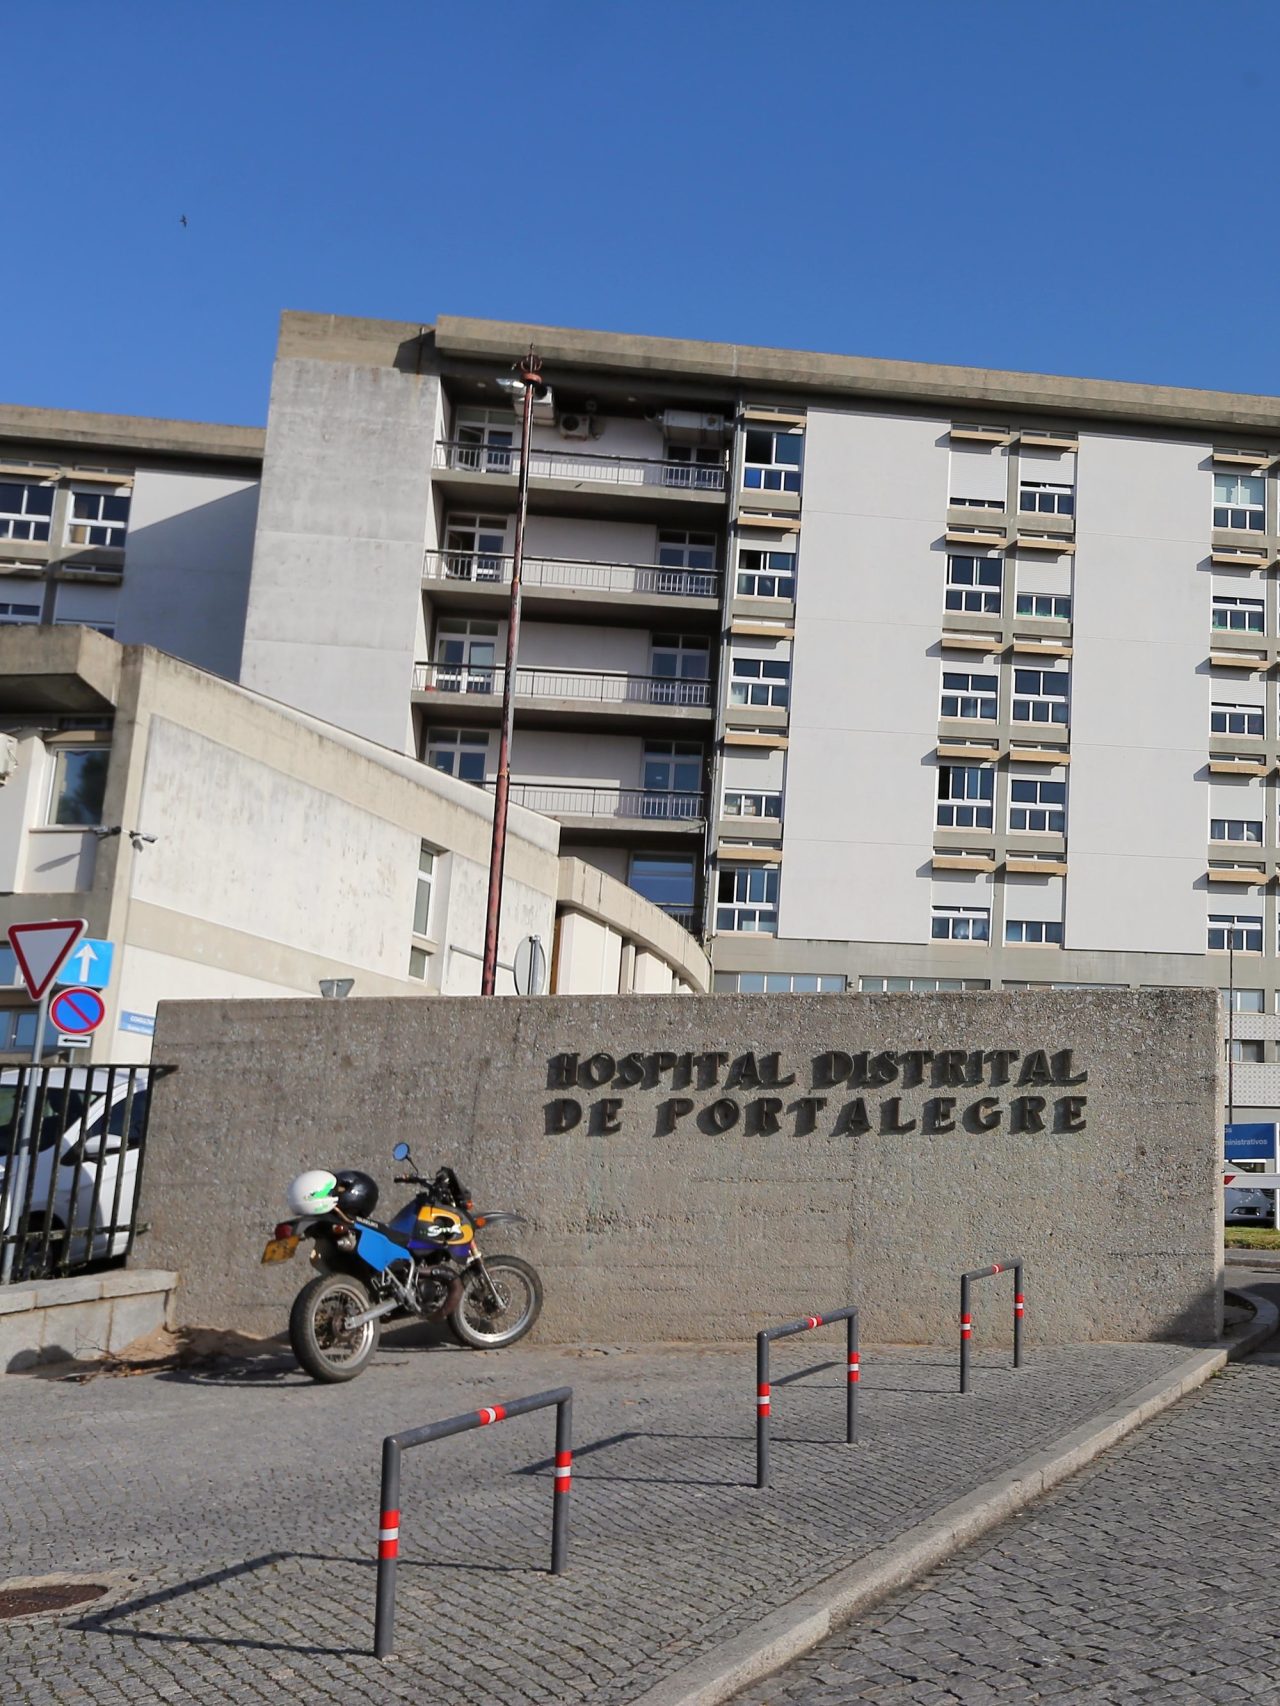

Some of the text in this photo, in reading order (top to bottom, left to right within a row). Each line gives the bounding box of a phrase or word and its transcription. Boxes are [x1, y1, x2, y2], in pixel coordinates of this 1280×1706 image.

[547, 1049, 1088, 1090] HOSPITAL DISTRITAL
[543, 1096, 1088, 1137] DE PORTALEGRE
[1224, 1138, 1268, 1146] ministrativos
